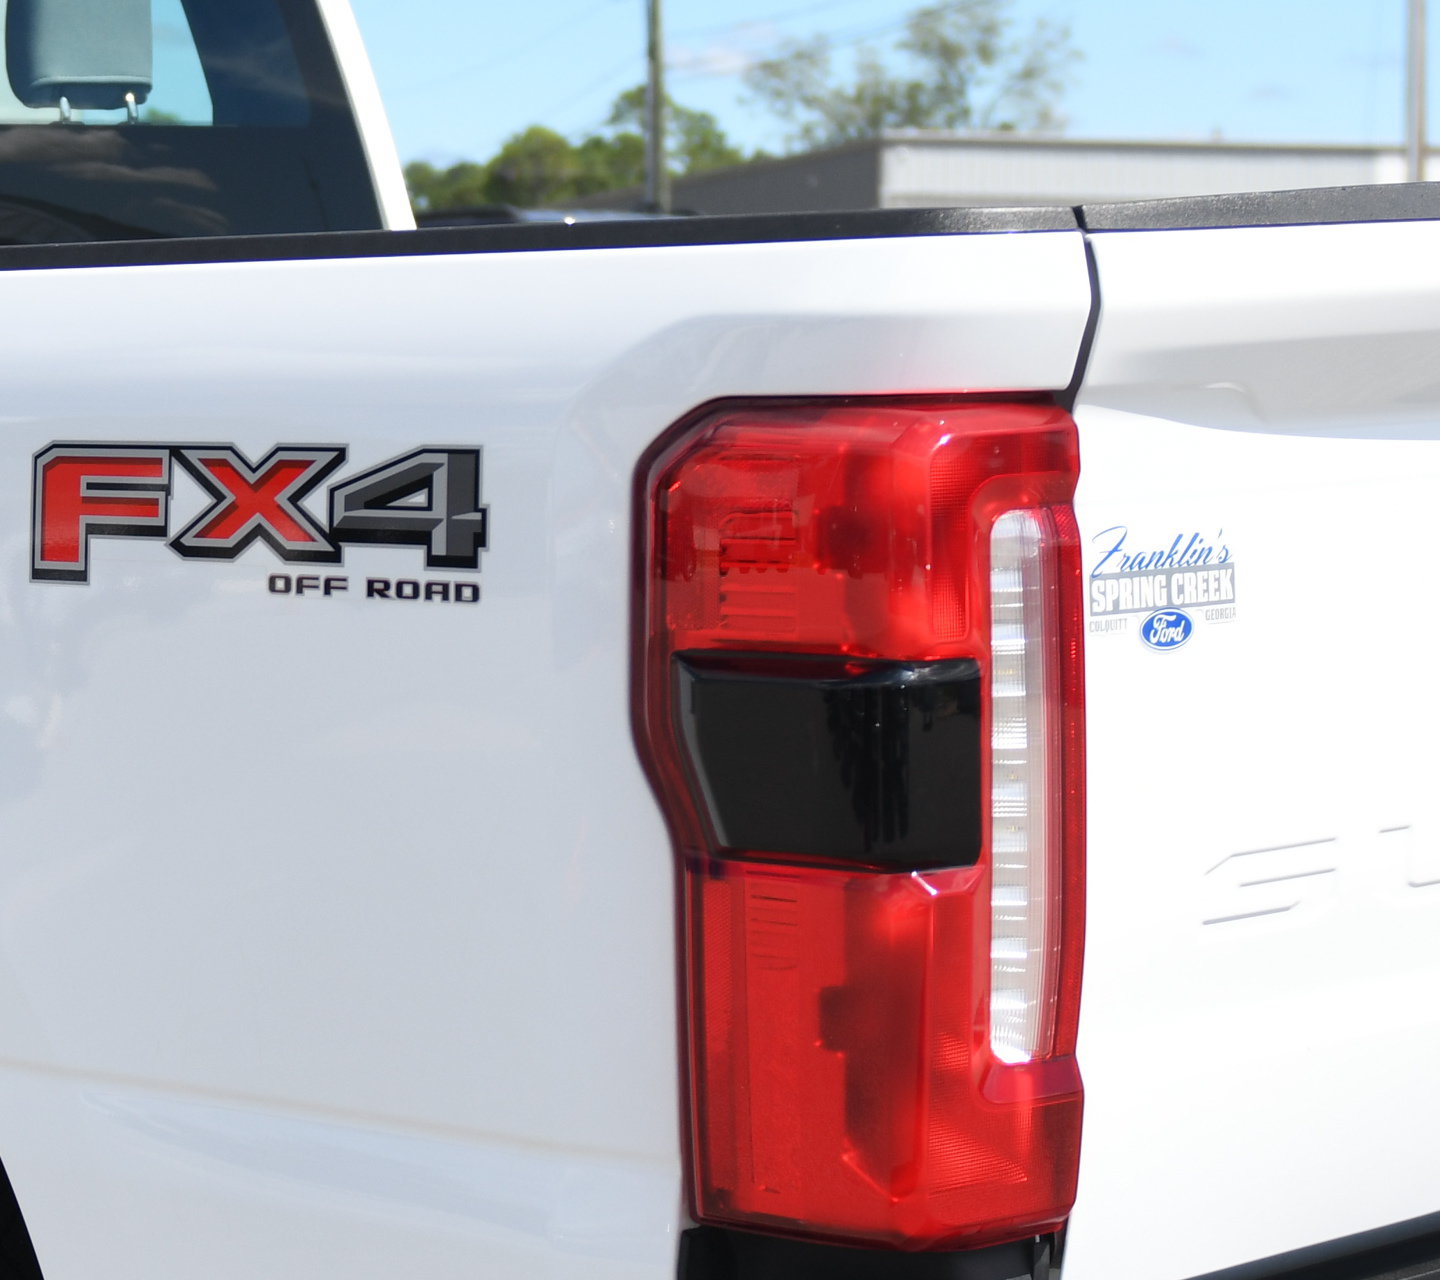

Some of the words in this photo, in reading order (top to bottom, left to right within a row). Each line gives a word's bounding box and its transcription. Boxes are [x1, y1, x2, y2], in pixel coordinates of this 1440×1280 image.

[29, 440, 490, 584] FX4
[1090, 525, 1233, 579] Franklin's
[268, 573, 349, 597] OFF
[366, 576, 482, 604] ROAD
[1091, 574, 1168, 614] SPRING
[1170, 568, 1235, 606] CREEK
[1089, 618, 1128, 633] COLQUITT
[1149, 613, 1185, 645] Ford
[1205, 607, 1237, 622] GEORGIA
